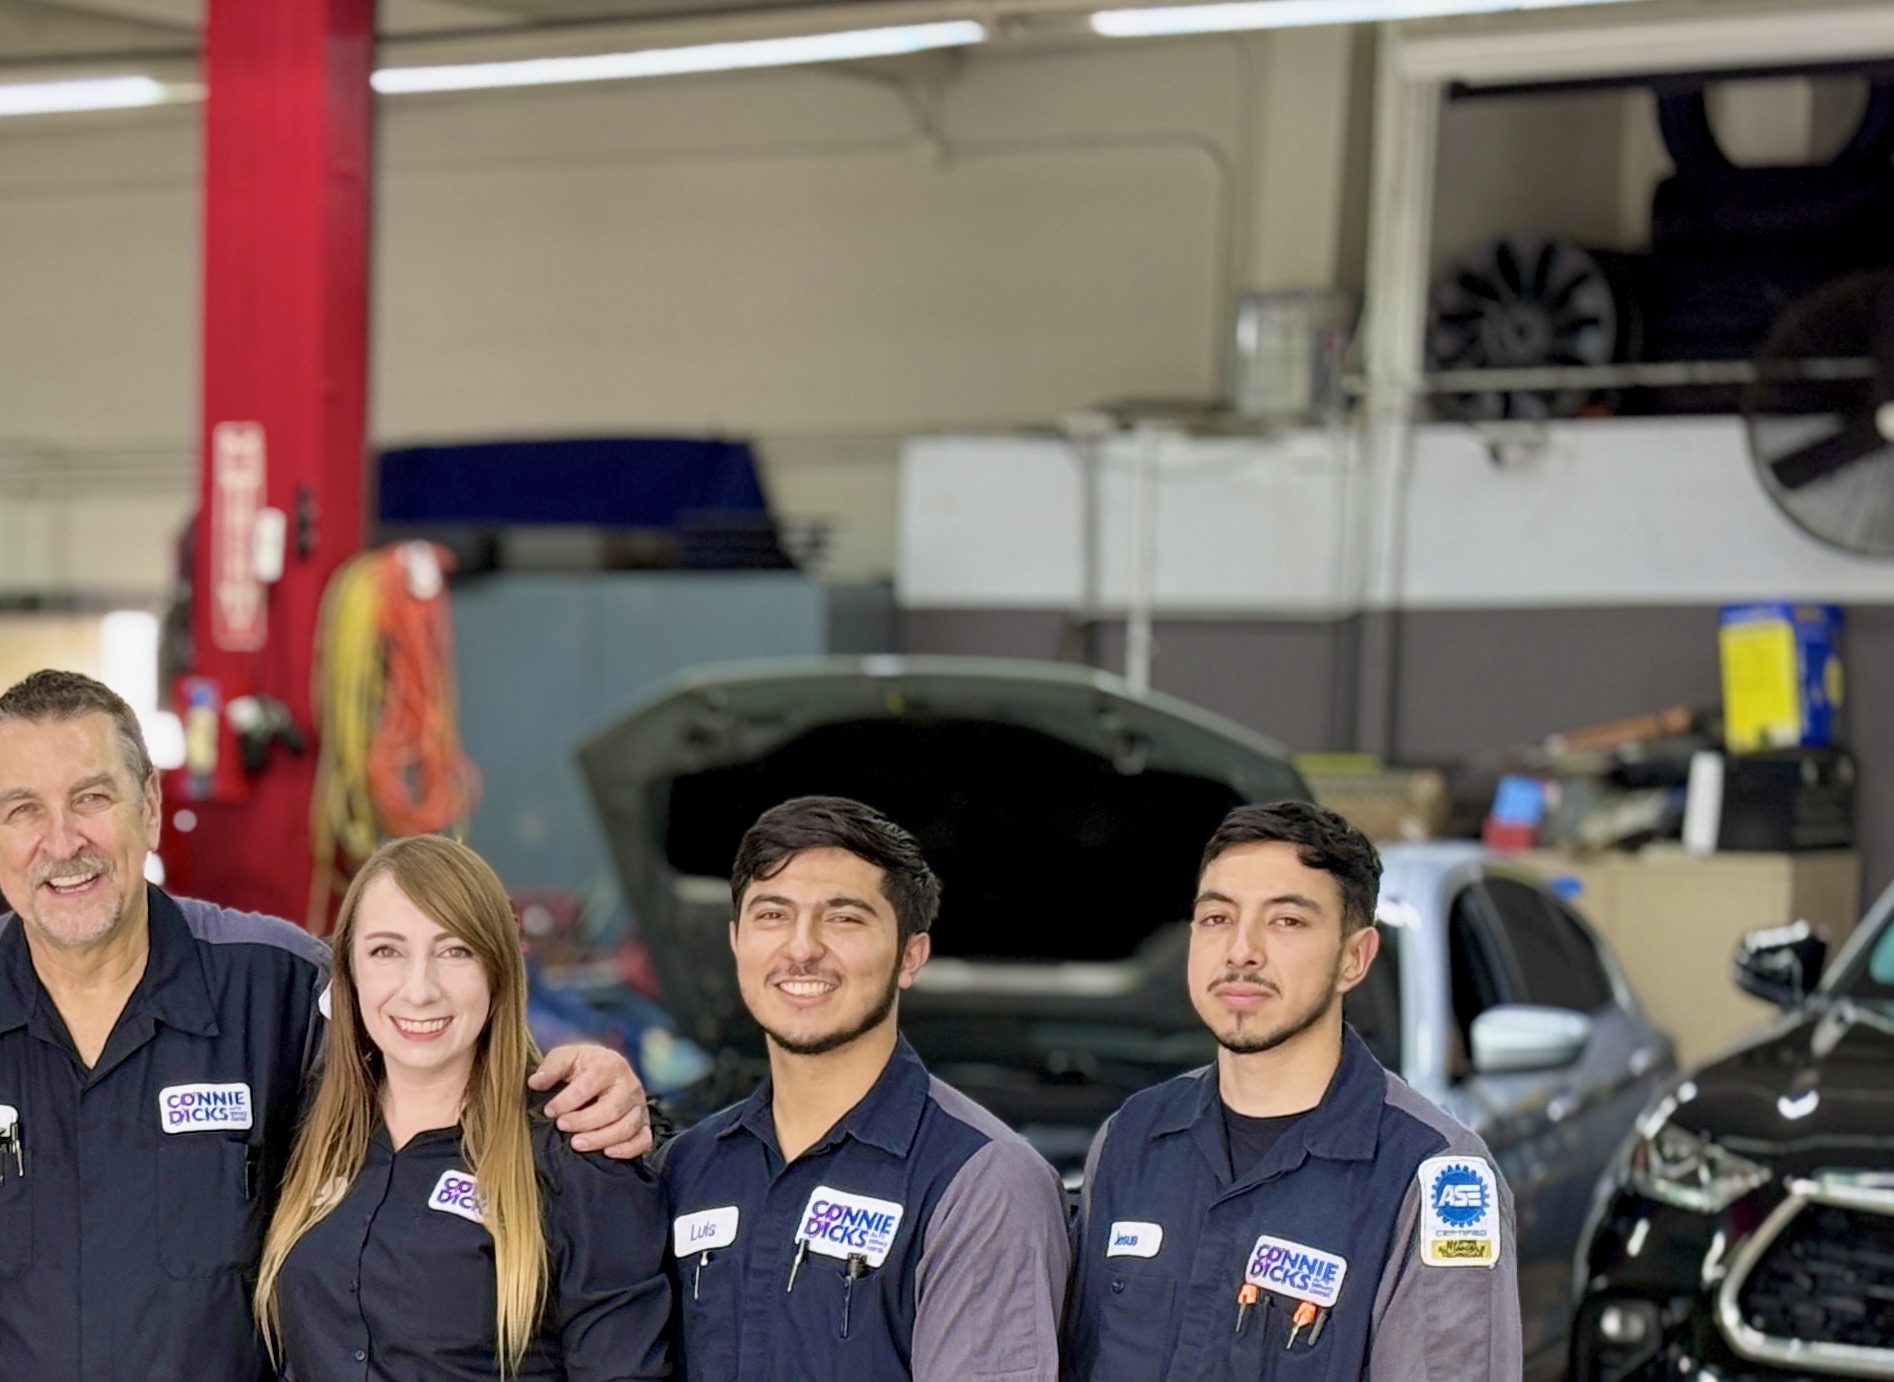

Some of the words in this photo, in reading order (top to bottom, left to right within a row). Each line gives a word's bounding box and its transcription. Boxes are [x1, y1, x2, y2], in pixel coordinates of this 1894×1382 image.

[167, 1091, 246, 1109] CONNIE
[169, 1107, 229, 1126] DICKS
[1438, 1184, 1483, 1207] ASE
[690, 1220, 717, 1242] Luis
[812, 1200, 896, 1235] CONNIE
[804, 1217, 869, 1248] DICKS
[1250, 1260, 1312, 1291] DICKS
[1257, 1244, 1340, 1282] CONNIE
